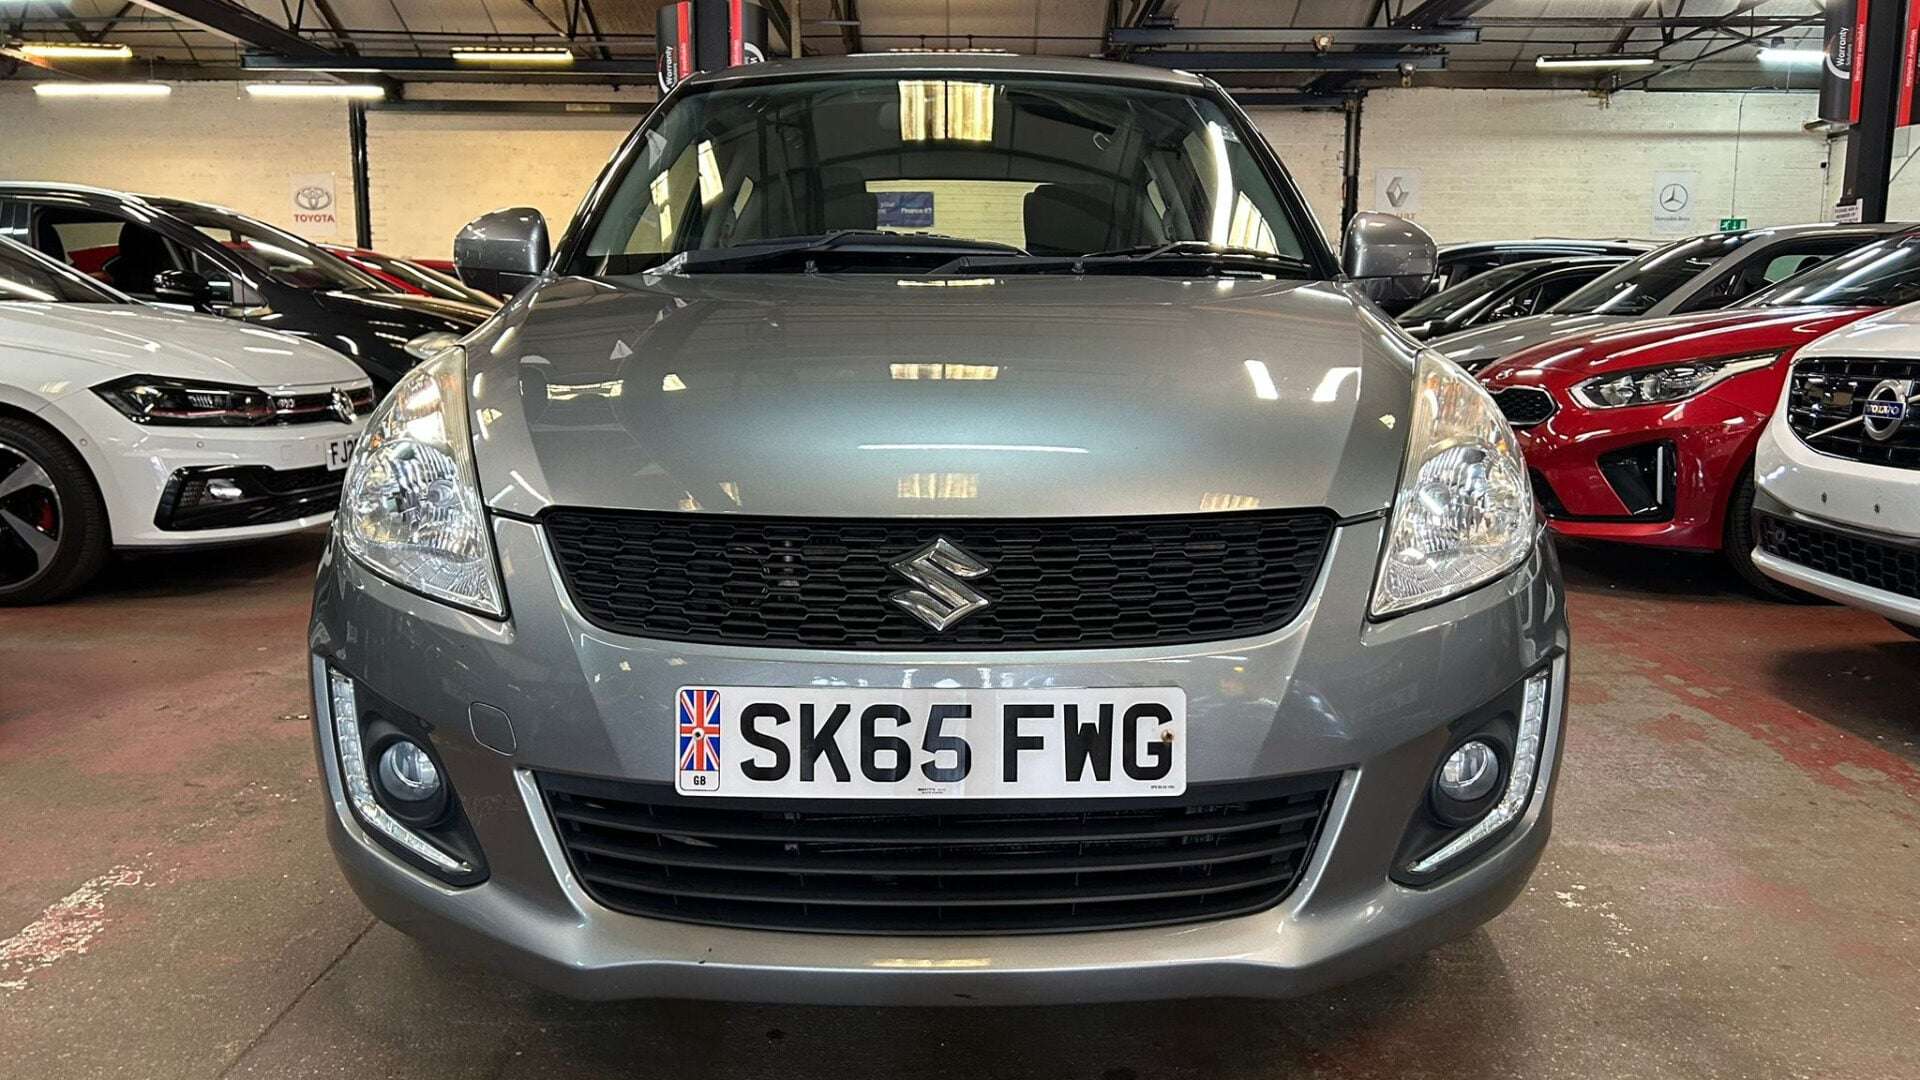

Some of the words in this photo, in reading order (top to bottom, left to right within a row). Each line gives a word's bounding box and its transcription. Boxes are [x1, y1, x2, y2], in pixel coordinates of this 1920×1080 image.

[1836, 26, 1849, 67] Warranty
[664, 46, 674, 86] Warranty
[294, 214, 335, 223] TOYOTA
[1865, 403, 1900, 415] VOLVO
[740, 703, 972, 782] SK65
[1003, 703, 1173, 782] FWG
[693, 776, 706, 785] GB
